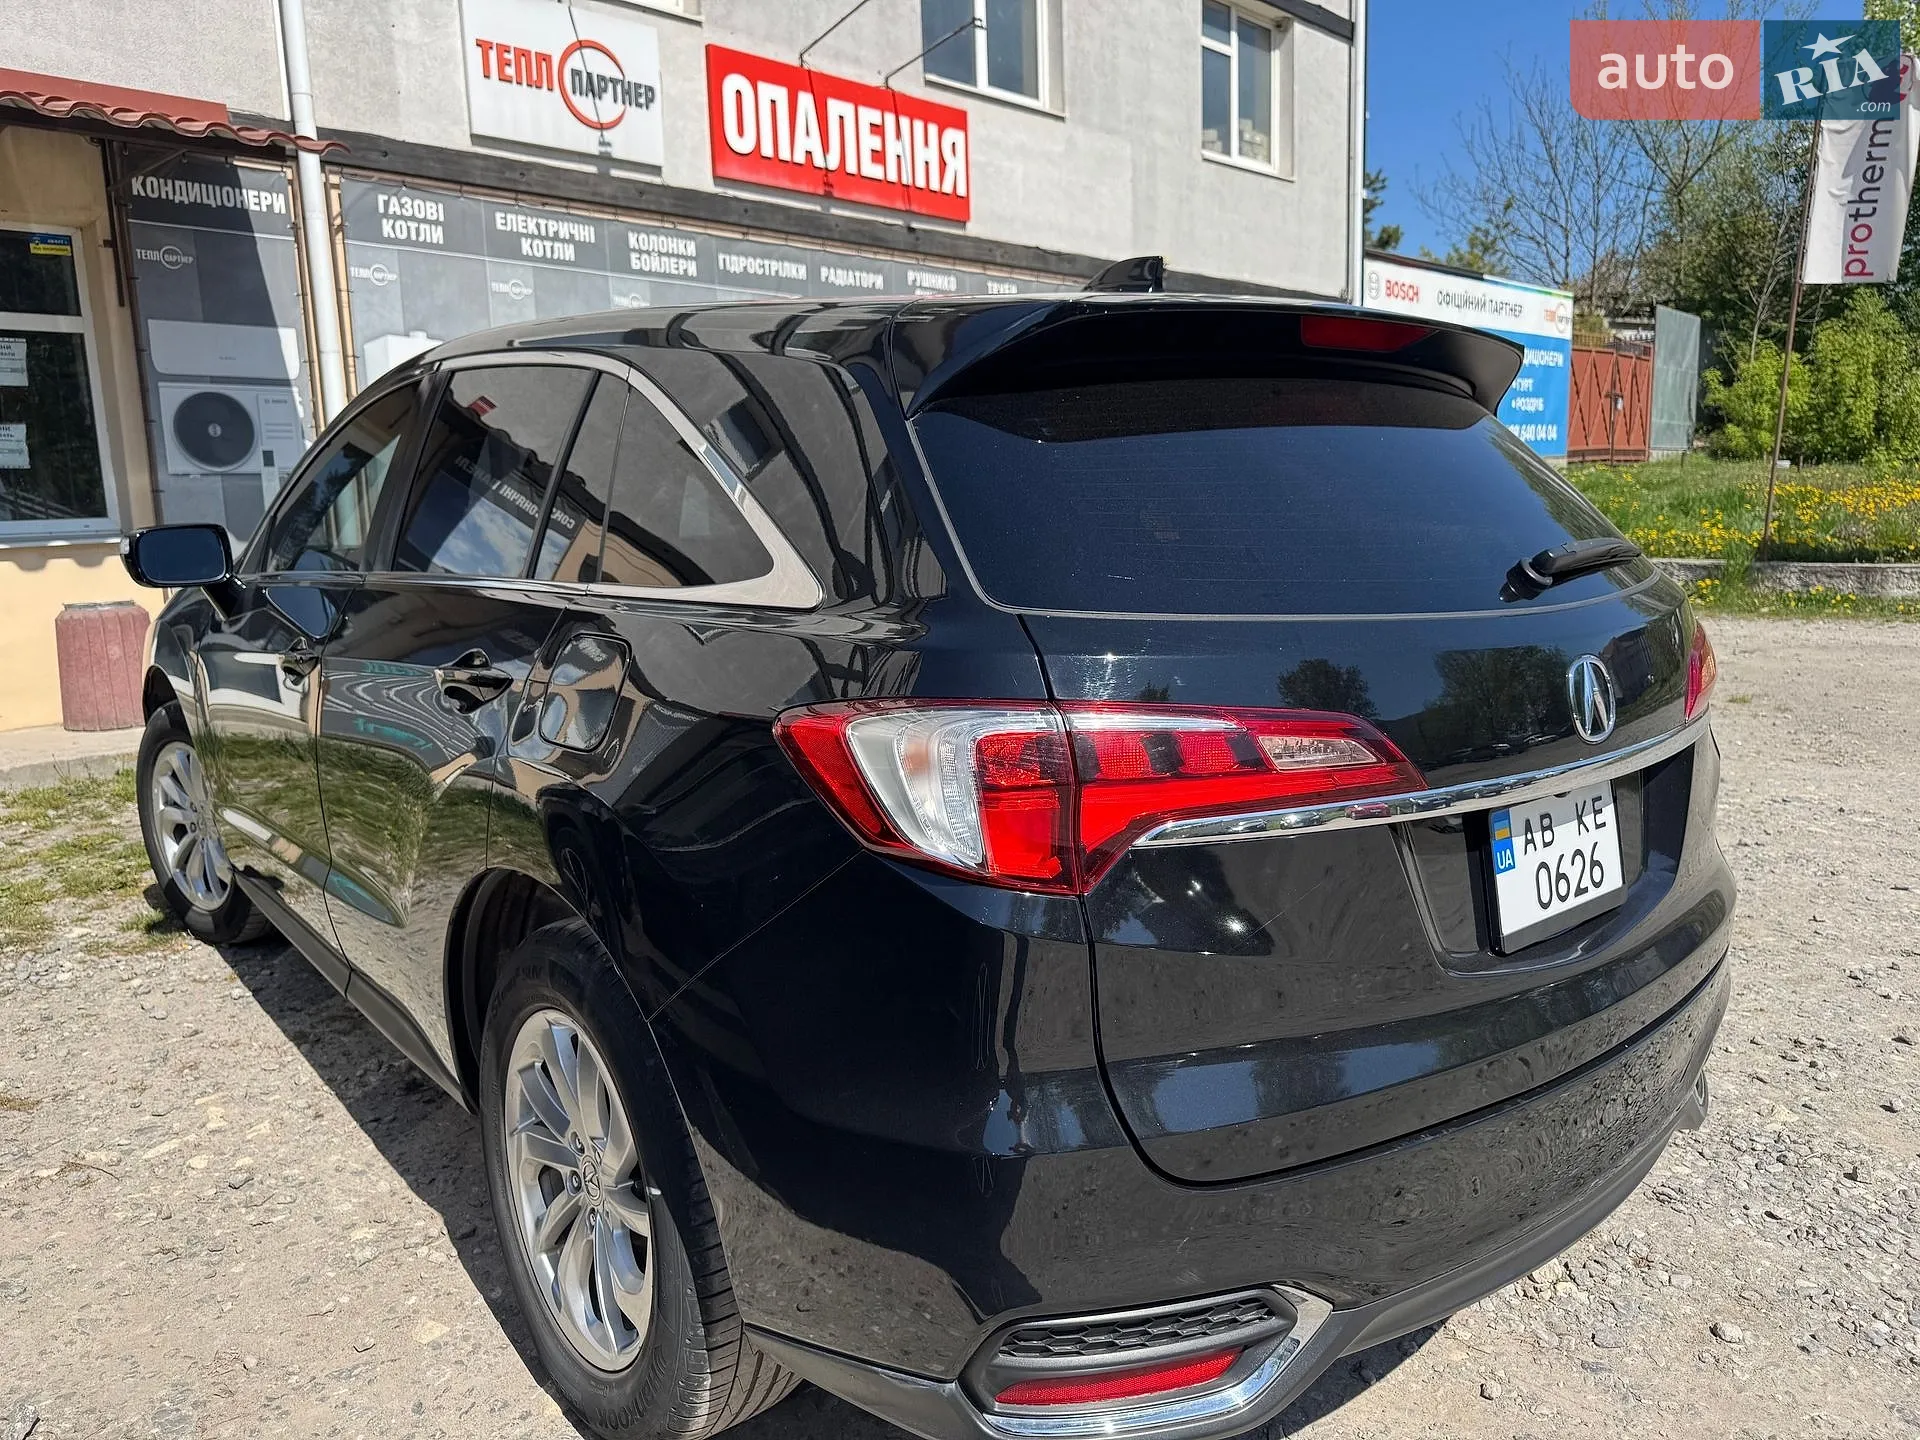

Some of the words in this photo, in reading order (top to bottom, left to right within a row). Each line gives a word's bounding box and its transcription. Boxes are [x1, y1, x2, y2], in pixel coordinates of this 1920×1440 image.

[570, 67, 656, 110] ПАРТНЕР
[721, 72, 967, 197] ОПАЛЕННЯ
[131, 175, 287, 214] КОНДИЦІОНЕРИ
[377, 193, 445, 222] ГАЗОВІ
[1843, 116, 1895, 277] protherm
[381, 218, 444, 245] КОТЛИ
[494, 211, 596, 243] ЕЛЕКТРИЧНІ
[520, 237, 576, 262] КОТЛИ
[627, 230, 697, 257] КОЛОНКИ
[630, 251, 698, 277] БОЙЛЕРИ
[717, 252, 808, 281] ГІДРОСТРІЛКИ
[820, 265, 884, 290] РАДІАТОРИ
[1385, 279, 1420, 303] BOSCH
[1436, 288, 1487, 313] ОФІЦІЙНИЙ
[1488, 299, 1523, 318] ПАРТНЕР
[1547, 423, 1557, 441] 04
[1523, 812, 1555, 856] AB
[1575, 795, 1607, 836] KE
[1497, 852, 1514, 870] UA
[1535, 841, 1605, 910] 0626
